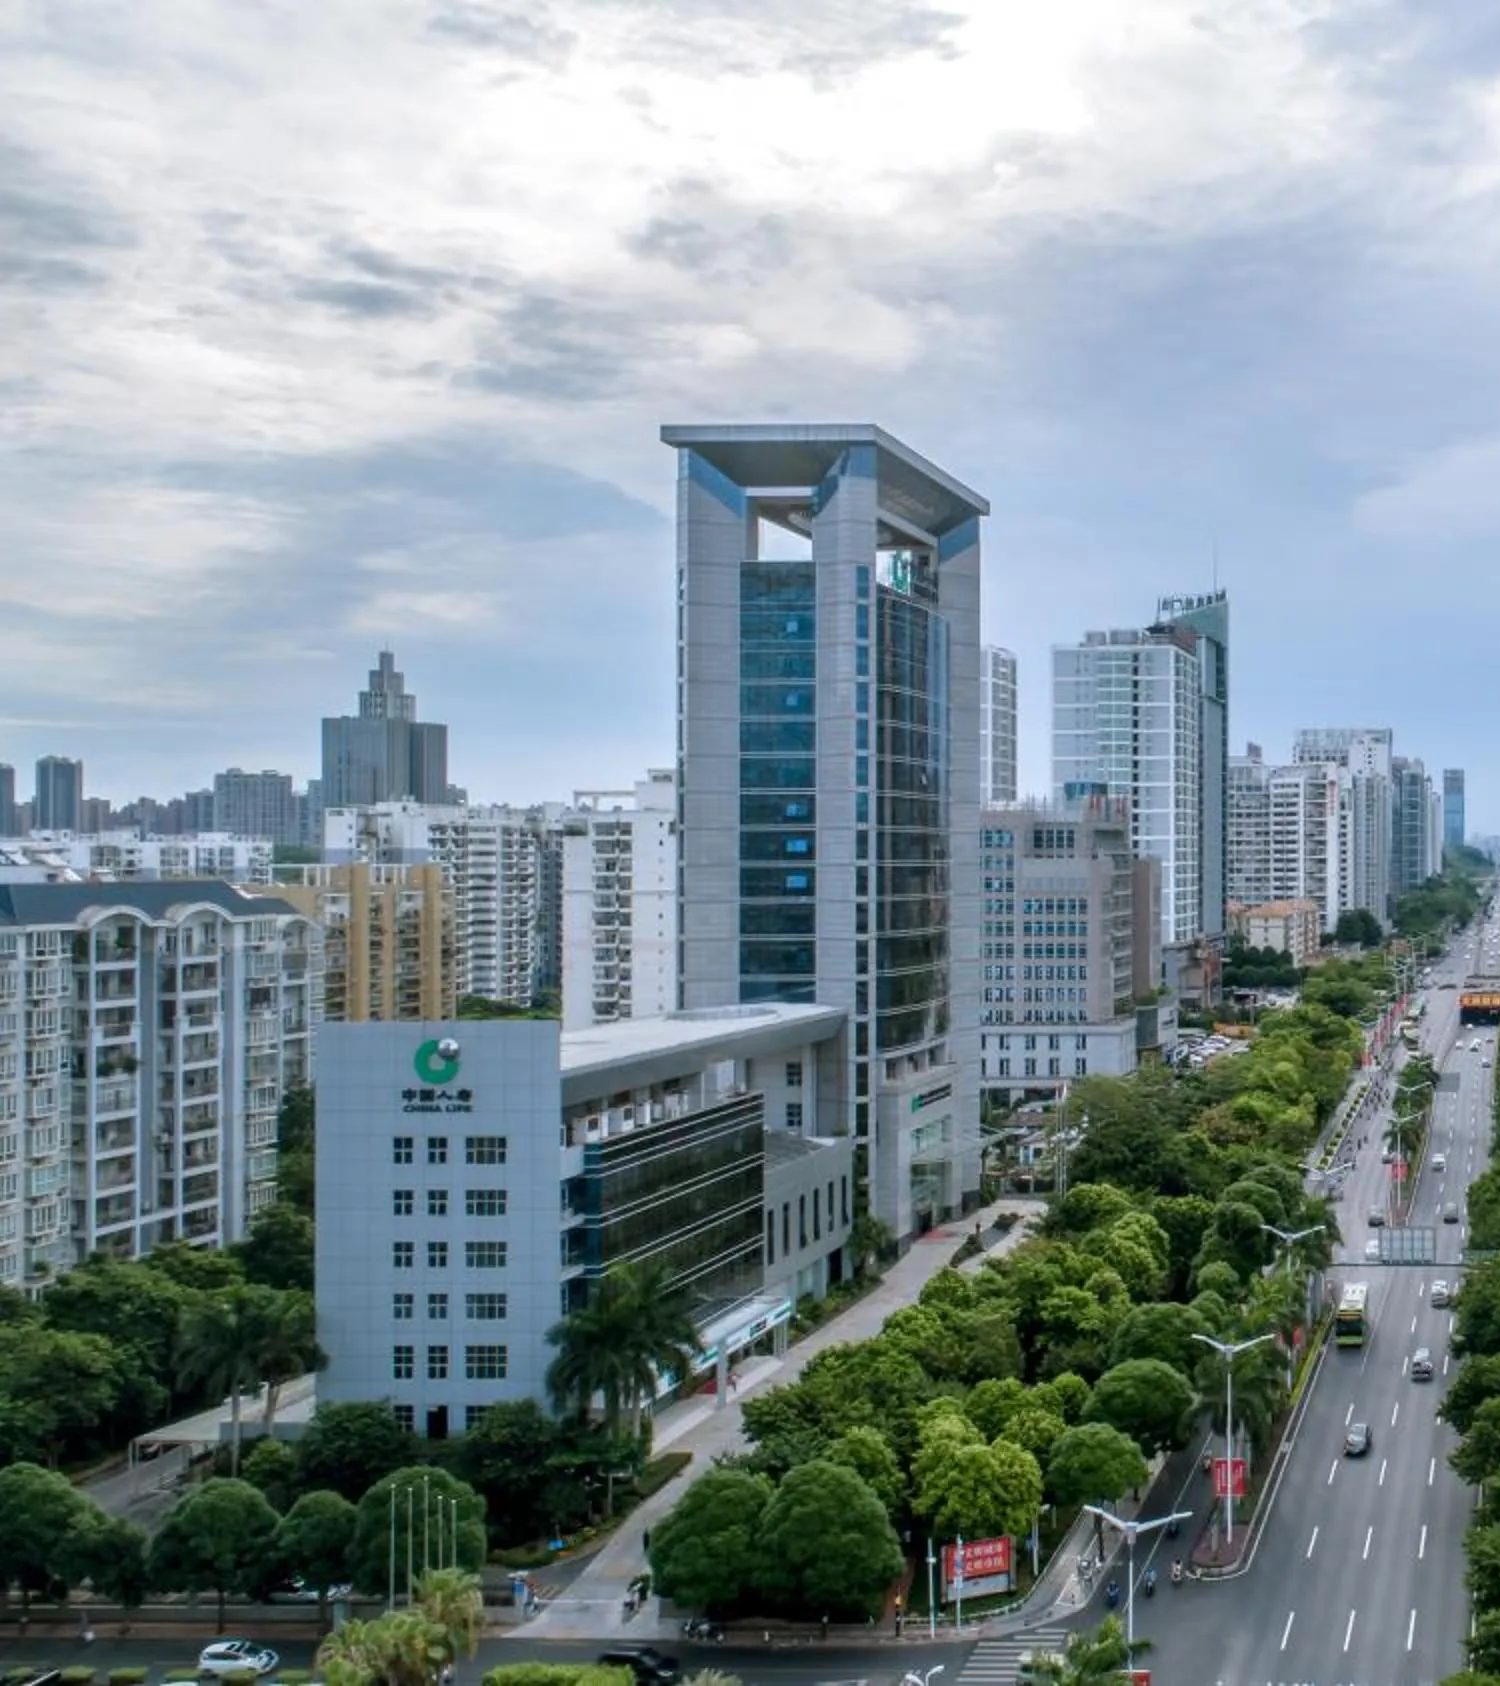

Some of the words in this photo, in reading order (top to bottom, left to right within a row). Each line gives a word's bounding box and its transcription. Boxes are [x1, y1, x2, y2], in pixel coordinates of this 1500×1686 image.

[401, 1088, 472, 1102] 中国人寿
[402, 1104, 442, 1113] CHINA
[445, 1104, 473, 1113] LIFE
